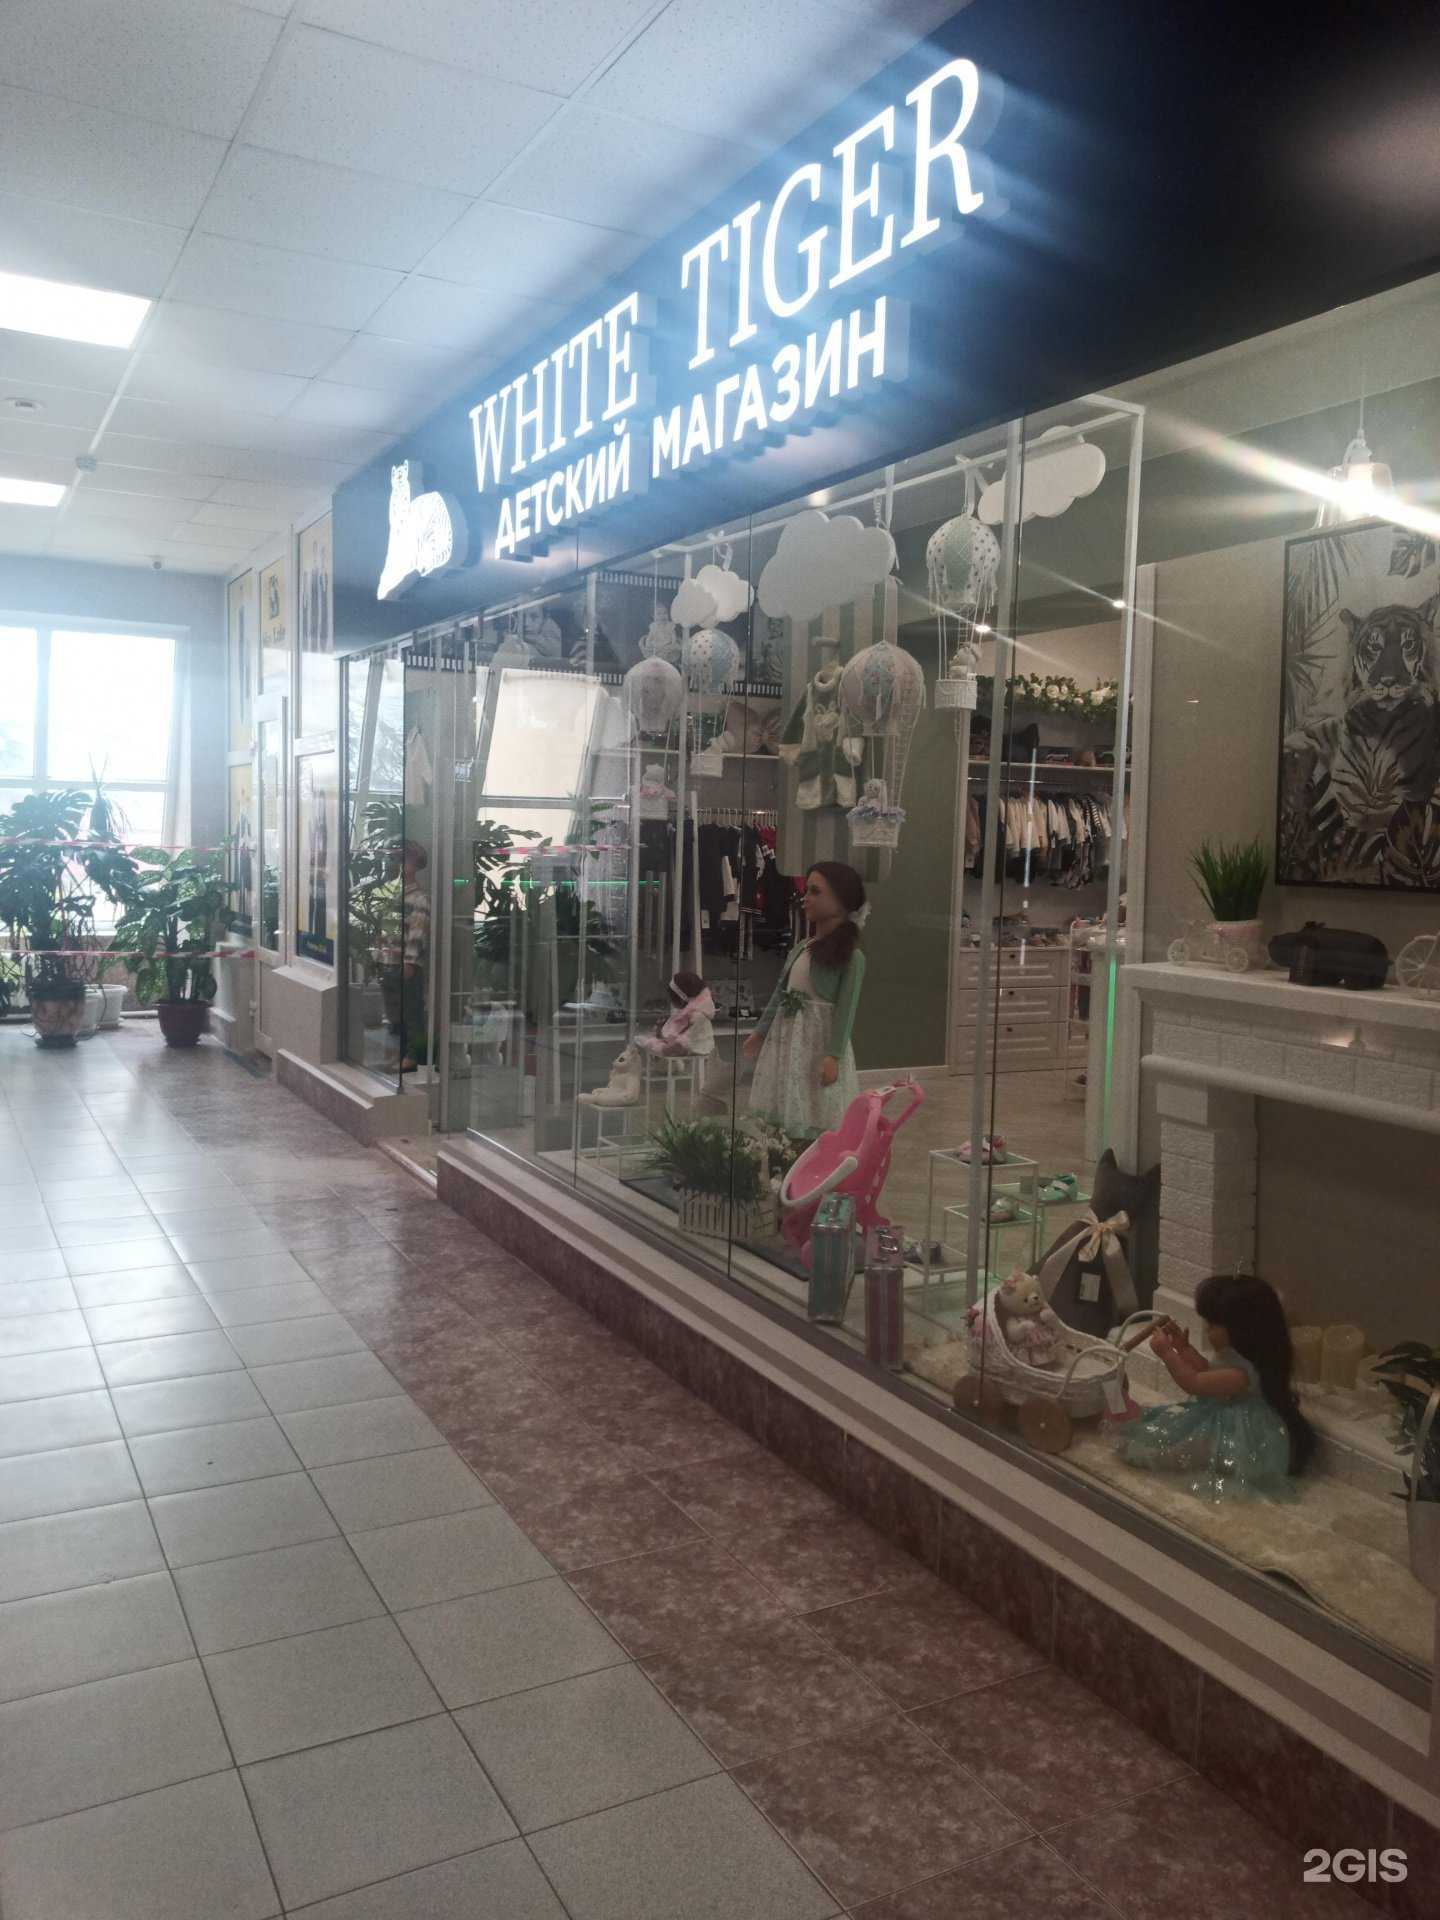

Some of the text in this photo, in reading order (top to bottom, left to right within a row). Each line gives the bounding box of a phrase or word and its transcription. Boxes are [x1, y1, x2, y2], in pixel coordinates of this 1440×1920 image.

[469, 58, 984, 492] WHITE TIGER
[495, 296, 887, 559] ДЕТСКИЙ МАГАЗИН
